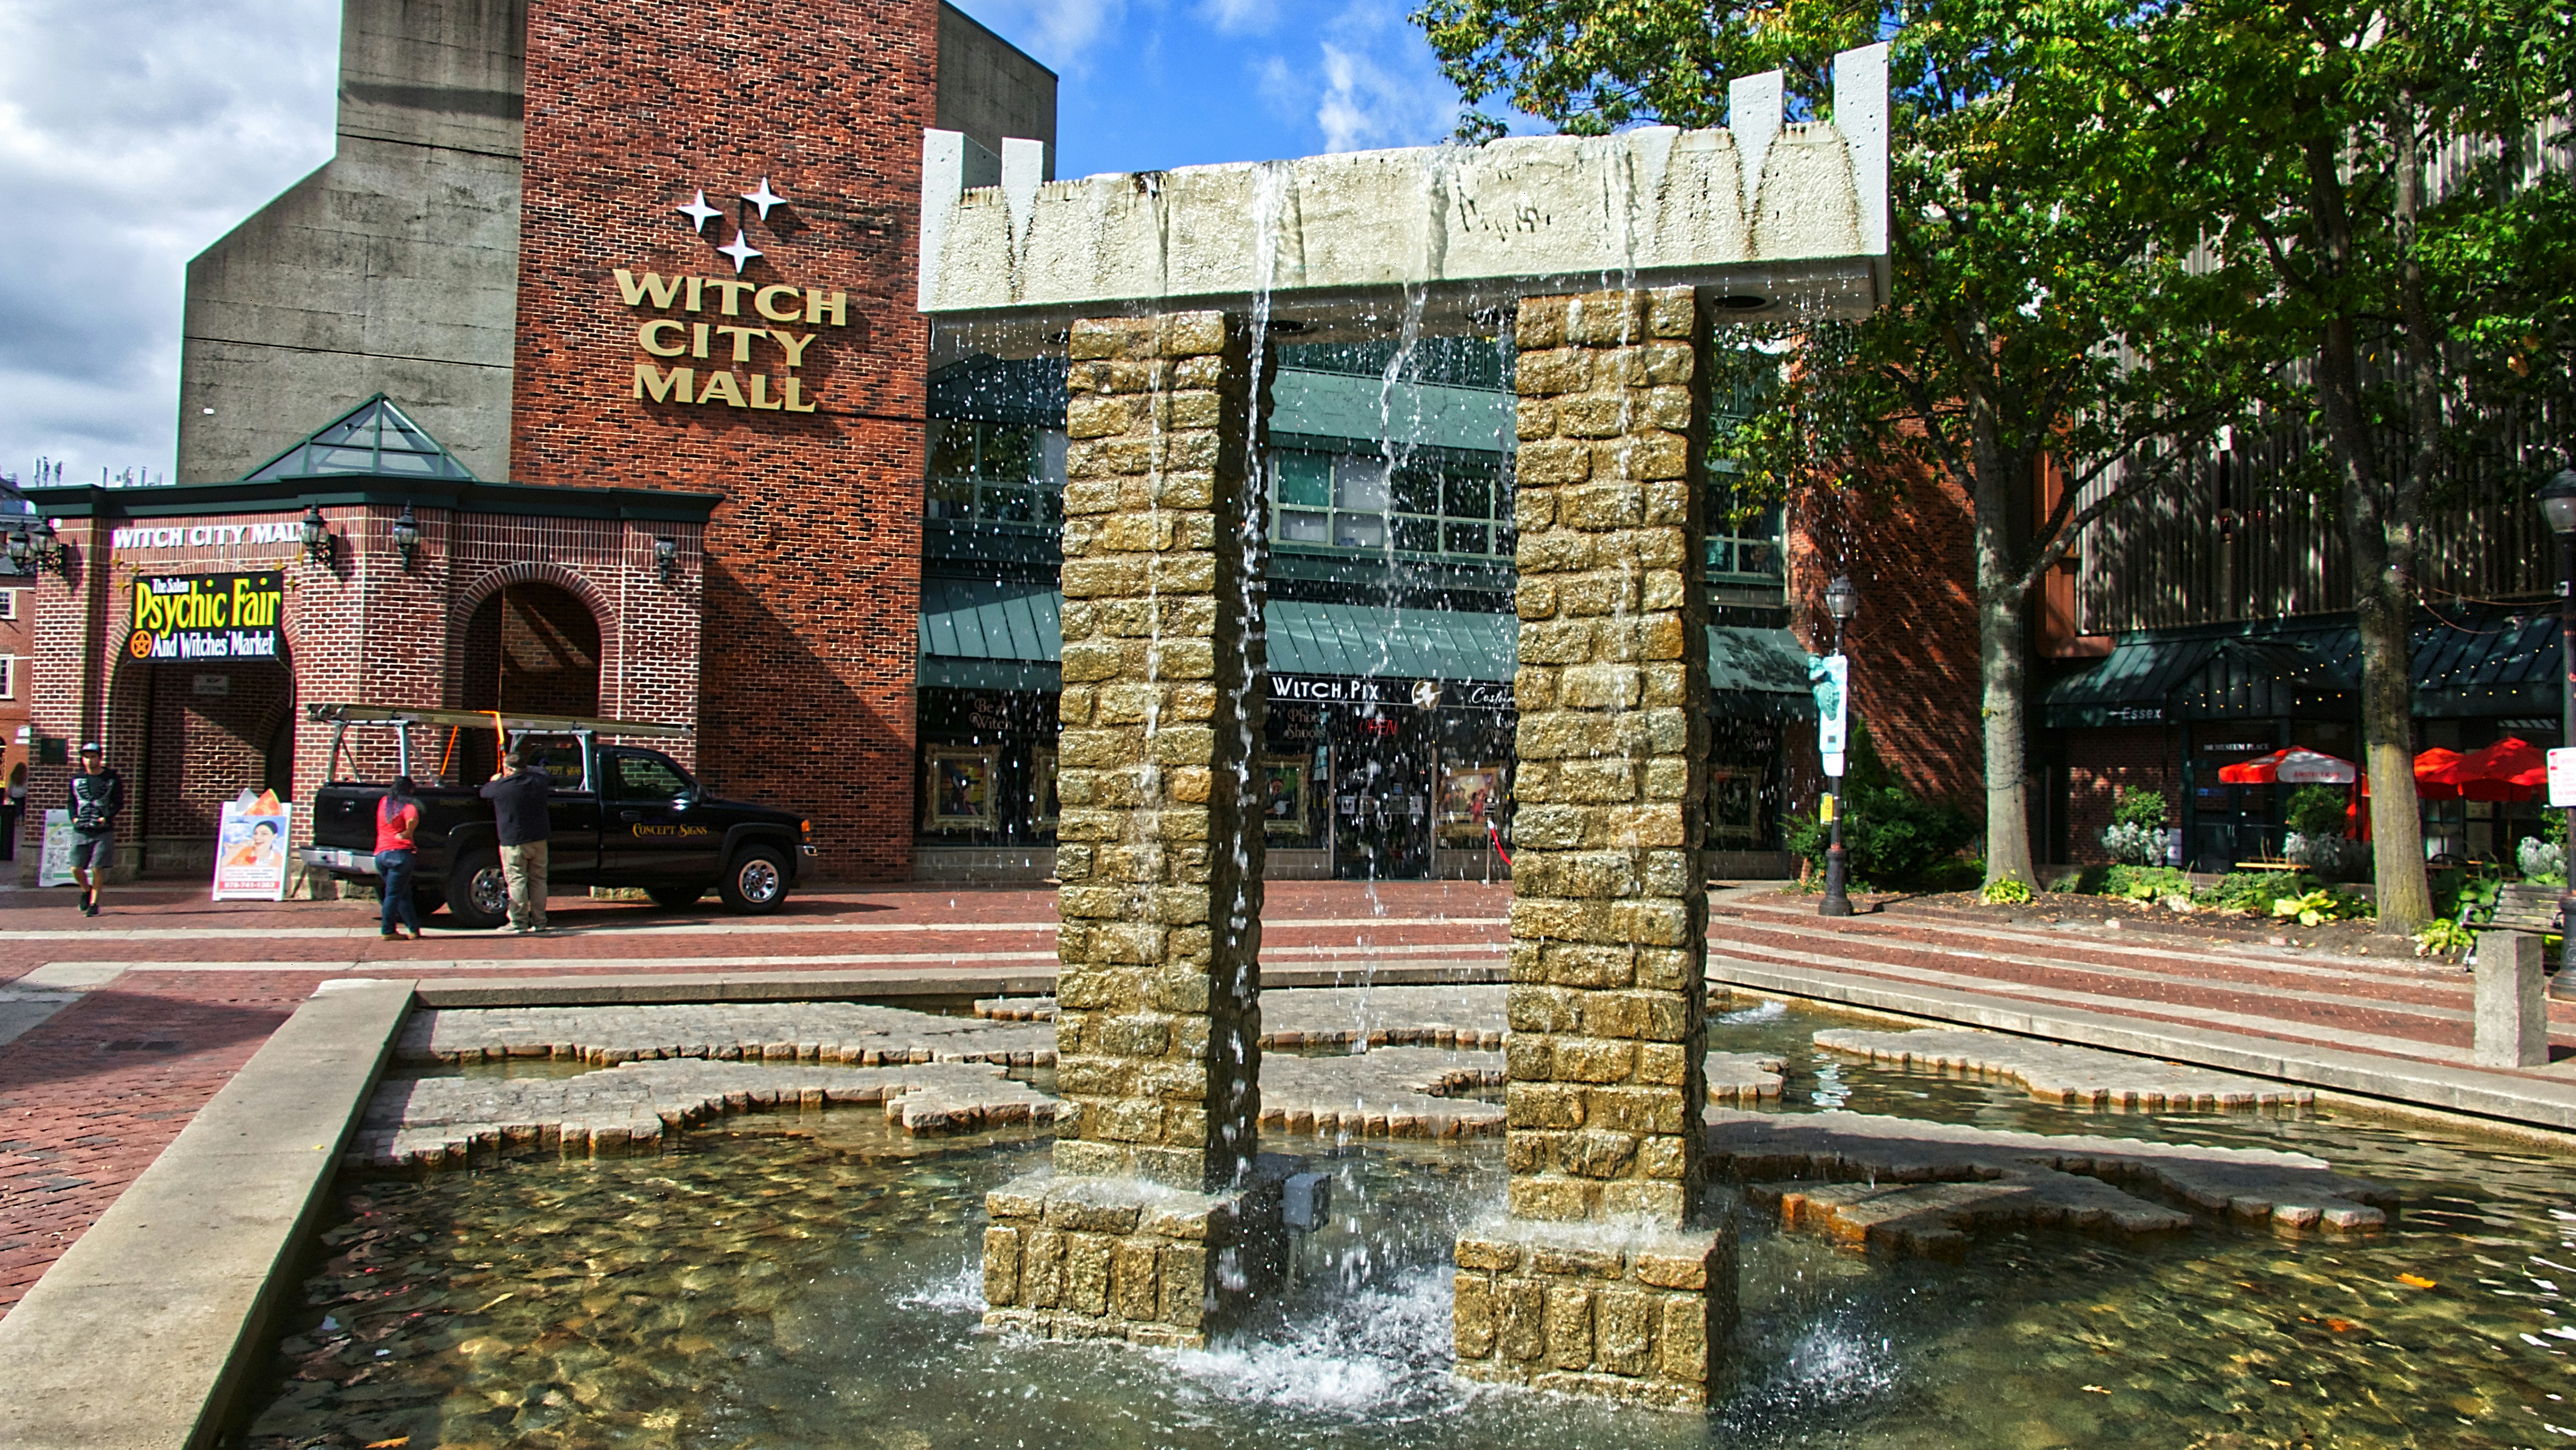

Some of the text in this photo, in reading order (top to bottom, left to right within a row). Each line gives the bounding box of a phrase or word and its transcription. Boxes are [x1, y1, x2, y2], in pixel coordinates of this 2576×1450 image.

[612, 268, 847, 326] WITCH
[638, 319, 816, 367] CITY
[633, 364, 816, 412] MALL
[113, 522, 305, 548] WITCH CITY MAL
[152, 578, 189, 593] The Salem
[135, 578, 281, 639] Psychic Fair
[151, 630, 275, 659] And Witches' Market
[974, 698, 994, 712] Be
[2122, 707, 2162, 720] Essex
[969, 712, 1012, 729] Witch
[1359, 719, 1397, 735] OPEN
[633, 823, 707, 838] CONCEPT SIGNS
